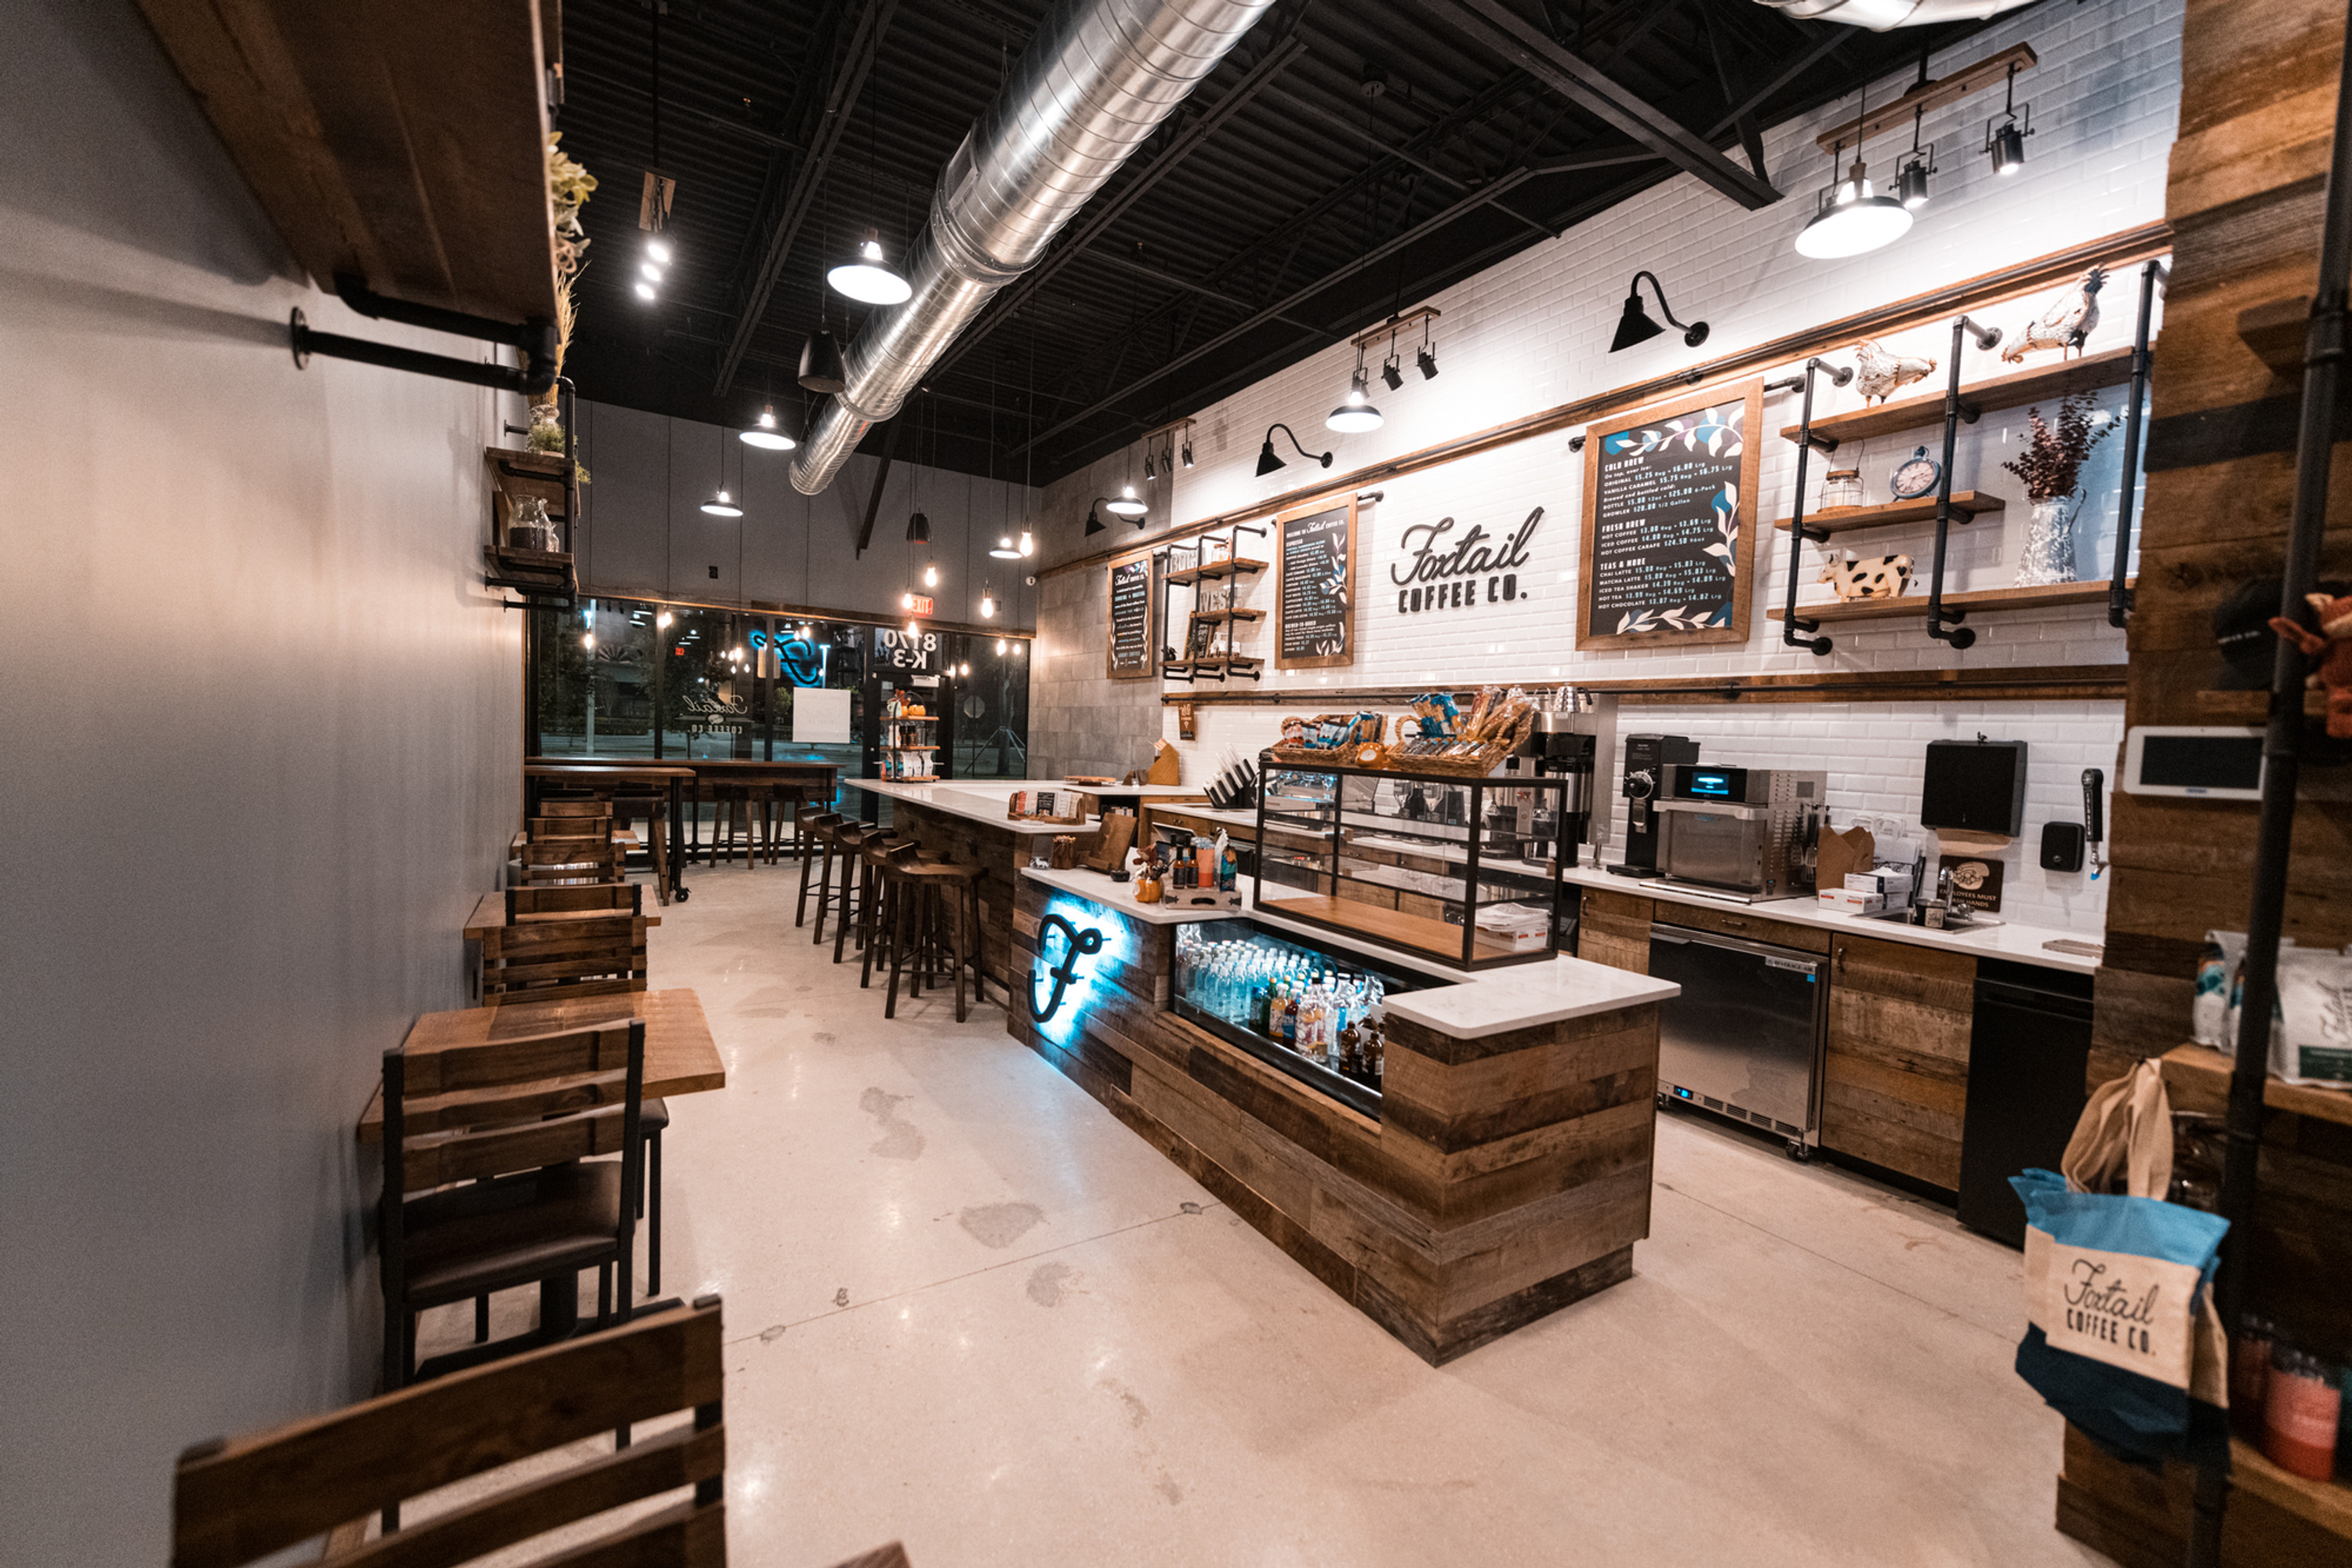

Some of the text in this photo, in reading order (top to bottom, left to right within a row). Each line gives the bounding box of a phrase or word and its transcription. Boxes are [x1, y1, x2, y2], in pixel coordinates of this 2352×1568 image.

[1605, 457, 1644, 472] COLD BREW
[1604, 477, 1632, 487] ORIGINAL
[1604, 486, 1627, 495] VANILLA
[1629, 480, 1656, 489] CARAMEL
[1637, 487, 1658, 495] bottled
[1603, 509, 1630, 518] GROWLER
[1602, 519, 1646, 533] FRESH BREW
[1391, 506, 1544, 586] Foxtail
[1600, 562, 1617, 571] TEAS
[1627, 558, 1646, 567] MORE
[1399, 574, 1527, 613] COFFEE CO.
[912, 597, 930, 614] EXIT
[1940, 889, 1976, 898] ELOYEES
[2064, 1258, 2159, 1325] Foxtail
[2067, 1308, 2118, 1344] COFFEE
